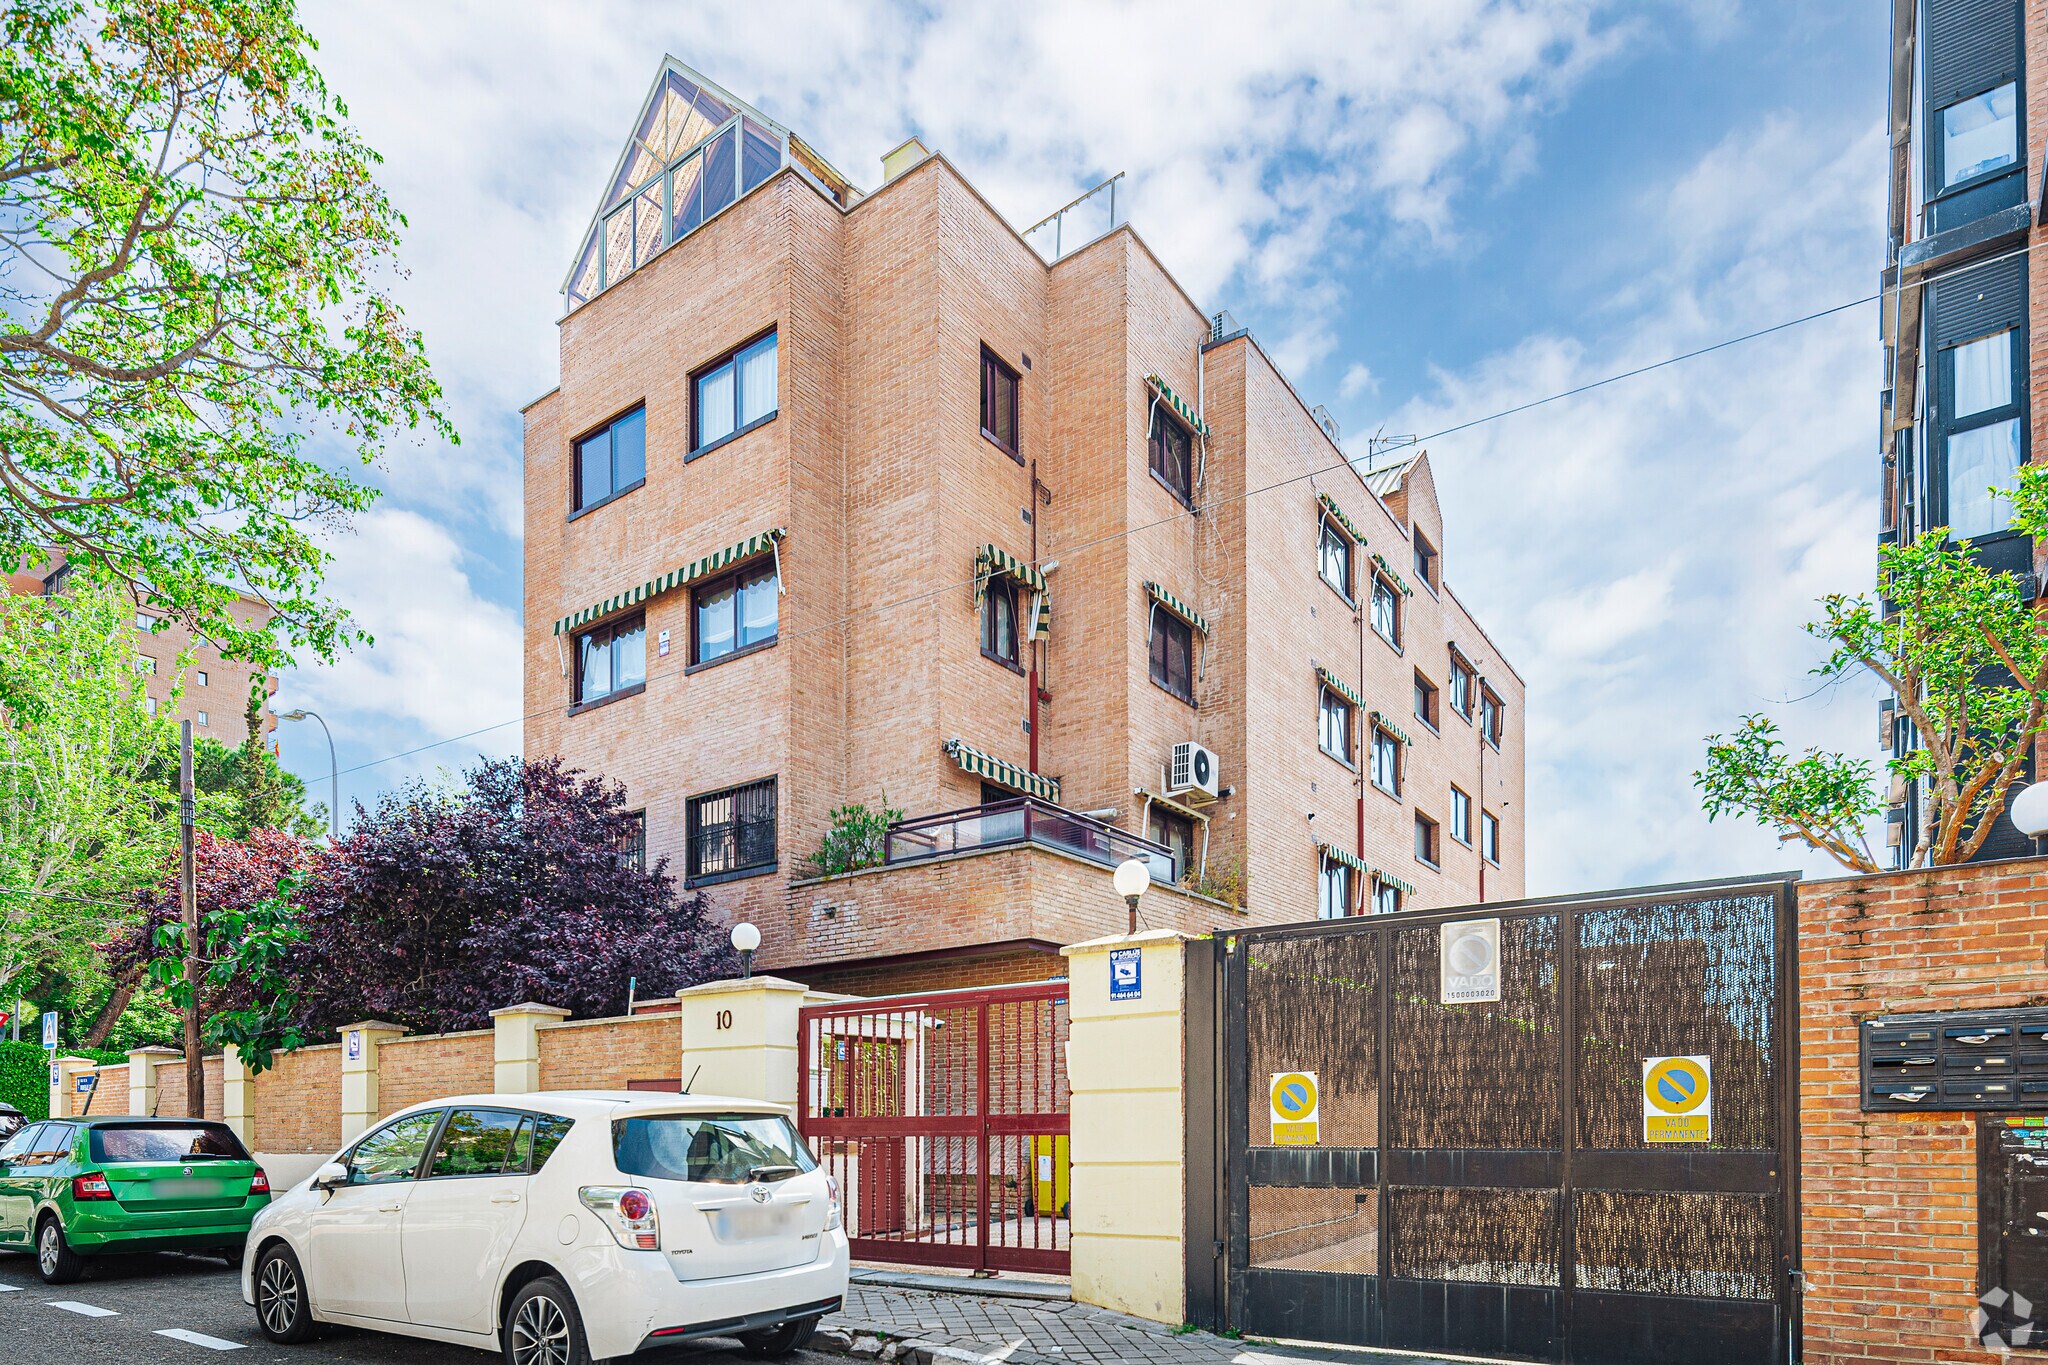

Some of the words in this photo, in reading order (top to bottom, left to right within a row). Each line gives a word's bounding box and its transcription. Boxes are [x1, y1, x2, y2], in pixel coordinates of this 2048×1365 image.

[1448, 975, 1494, 988] VADO
[1447, 990, 1495, 998] 1500003020
[716, 1009, 732, 1030] 10
[1665, 1118, 1690, 1127] VADO
[1650, 1129, 1704, 1138] PERMANENTE
